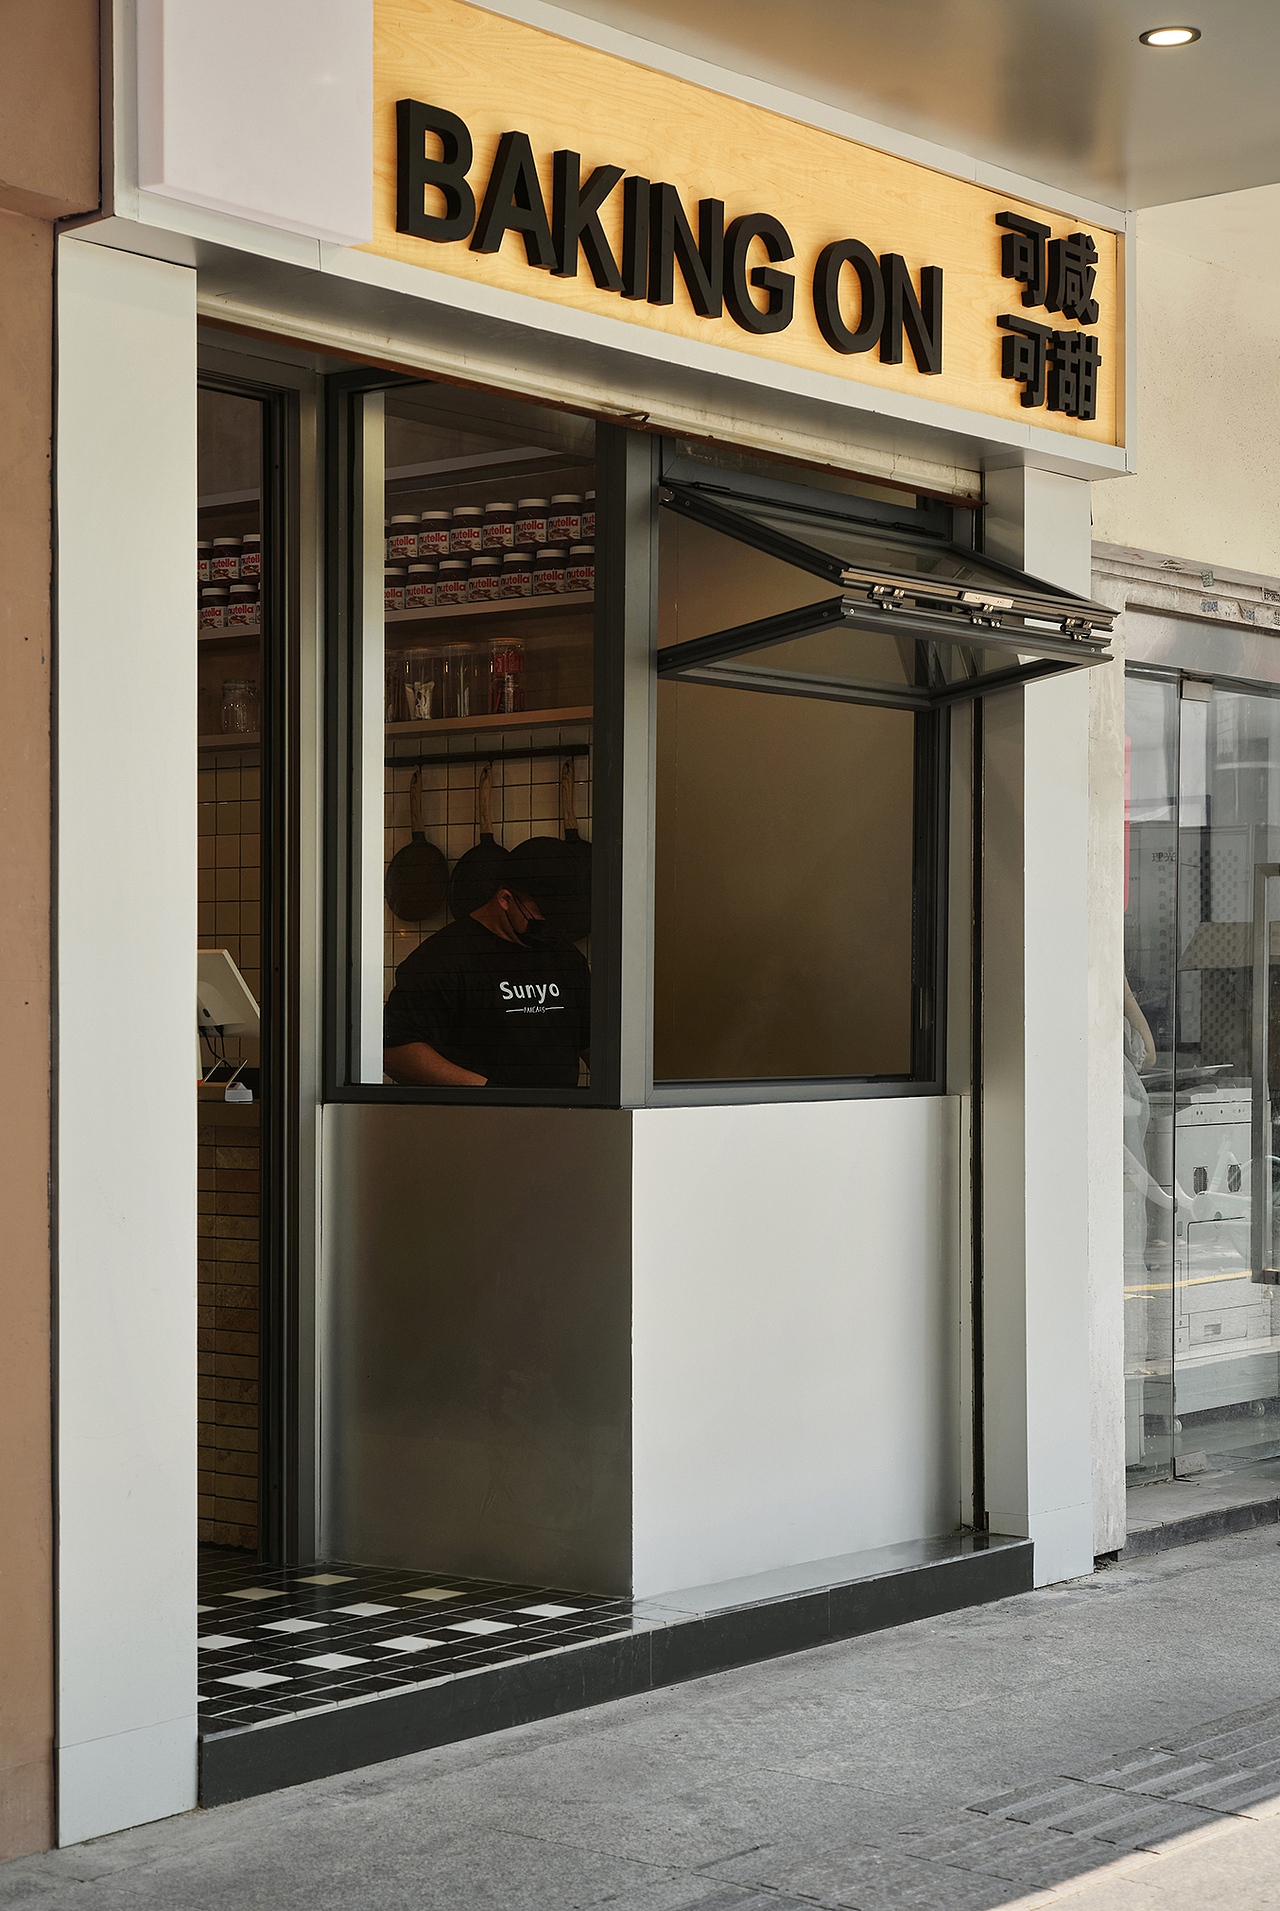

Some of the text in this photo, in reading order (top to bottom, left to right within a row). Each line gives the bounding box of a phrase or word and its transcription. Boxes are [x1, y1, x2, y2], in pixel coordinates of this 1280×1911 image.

[395, 98, 943, 375] BAKING ON
[996, 211, 1099, 325] 可咸
[996, 314, 1101, 420] 可甜
[515, 520, 544, 532] nutella
[548, 516, 579, 528] nutella
[451, 528, 480, 540] nutella
[483, 524, 512, 536] nutella
[501, 573, 530, 586] nutella
[534, 569, 565, 582] nutella
[437, 579, 466, 592] nutella
[469, 576, 499, 589] nutella
[499, 981, 560, 1004] Sunyo
